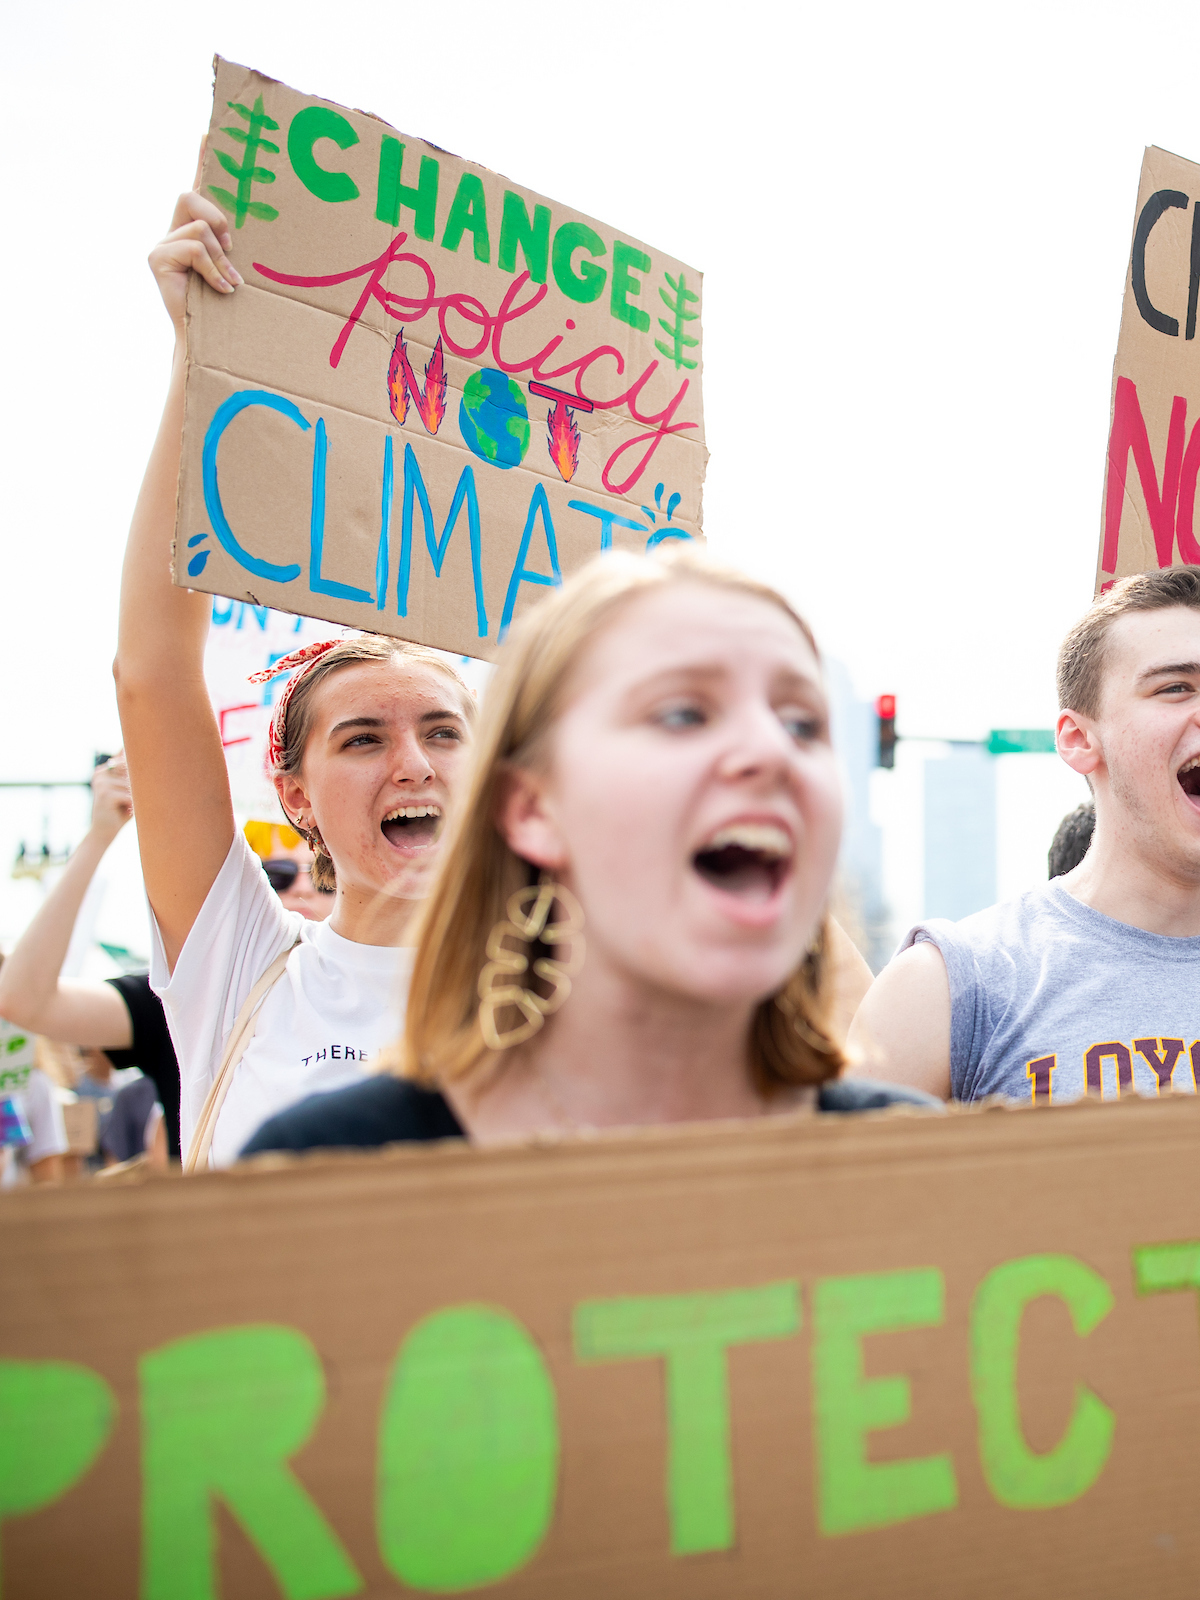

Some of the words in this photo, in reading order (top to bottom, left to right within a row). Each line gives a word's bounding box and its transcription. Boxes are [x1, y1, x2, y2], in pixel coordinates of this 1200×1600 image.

[287, 106, 651, 332] CHANGE
[252, 231, 699, 495] policy
[387, 326, 594, 483] NOT
[301, 1044, 368, 1067] THERE
